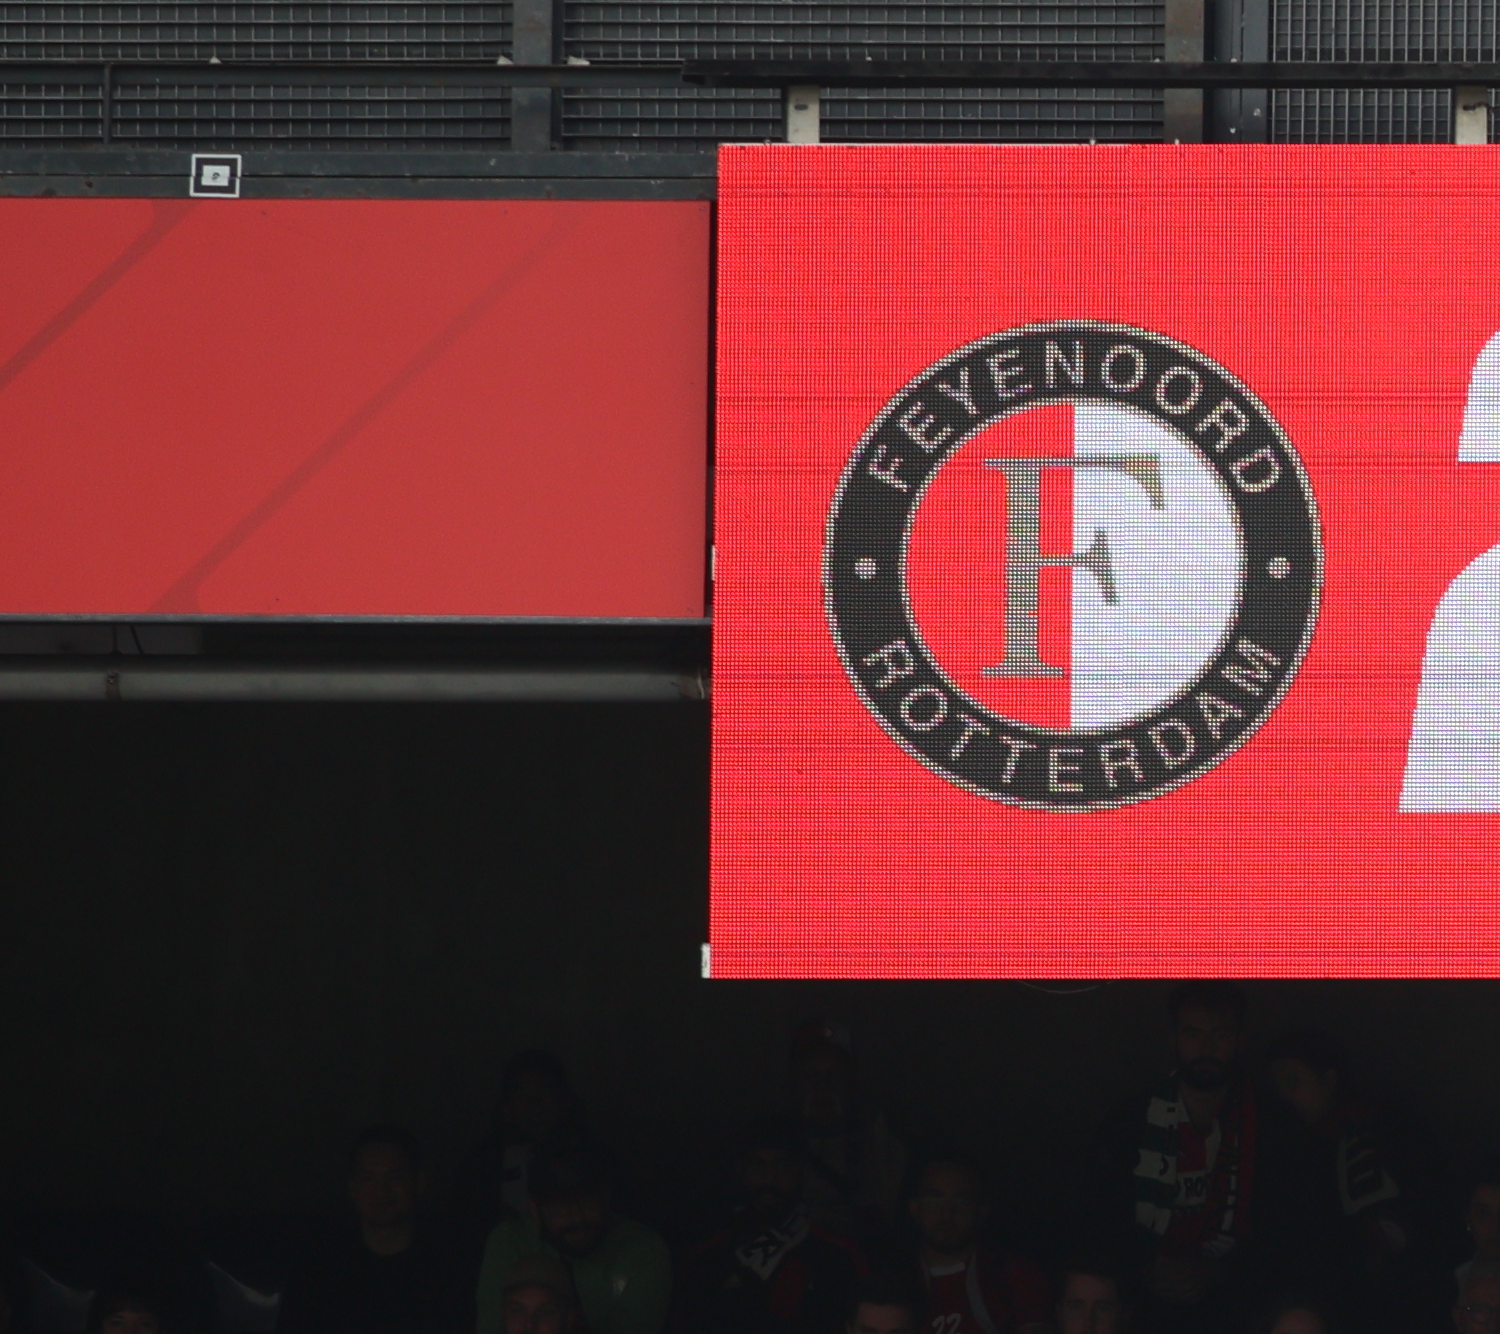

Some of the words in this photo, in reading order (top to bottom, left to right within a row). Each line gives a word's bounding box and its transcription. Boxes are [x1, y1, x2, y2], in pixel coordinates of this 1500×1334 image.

[866, 342, 1282, 497] FEYENOORD
[981, 454, 1165, 678] F
[862, 637, 1286, 795] ROTTERDAM
